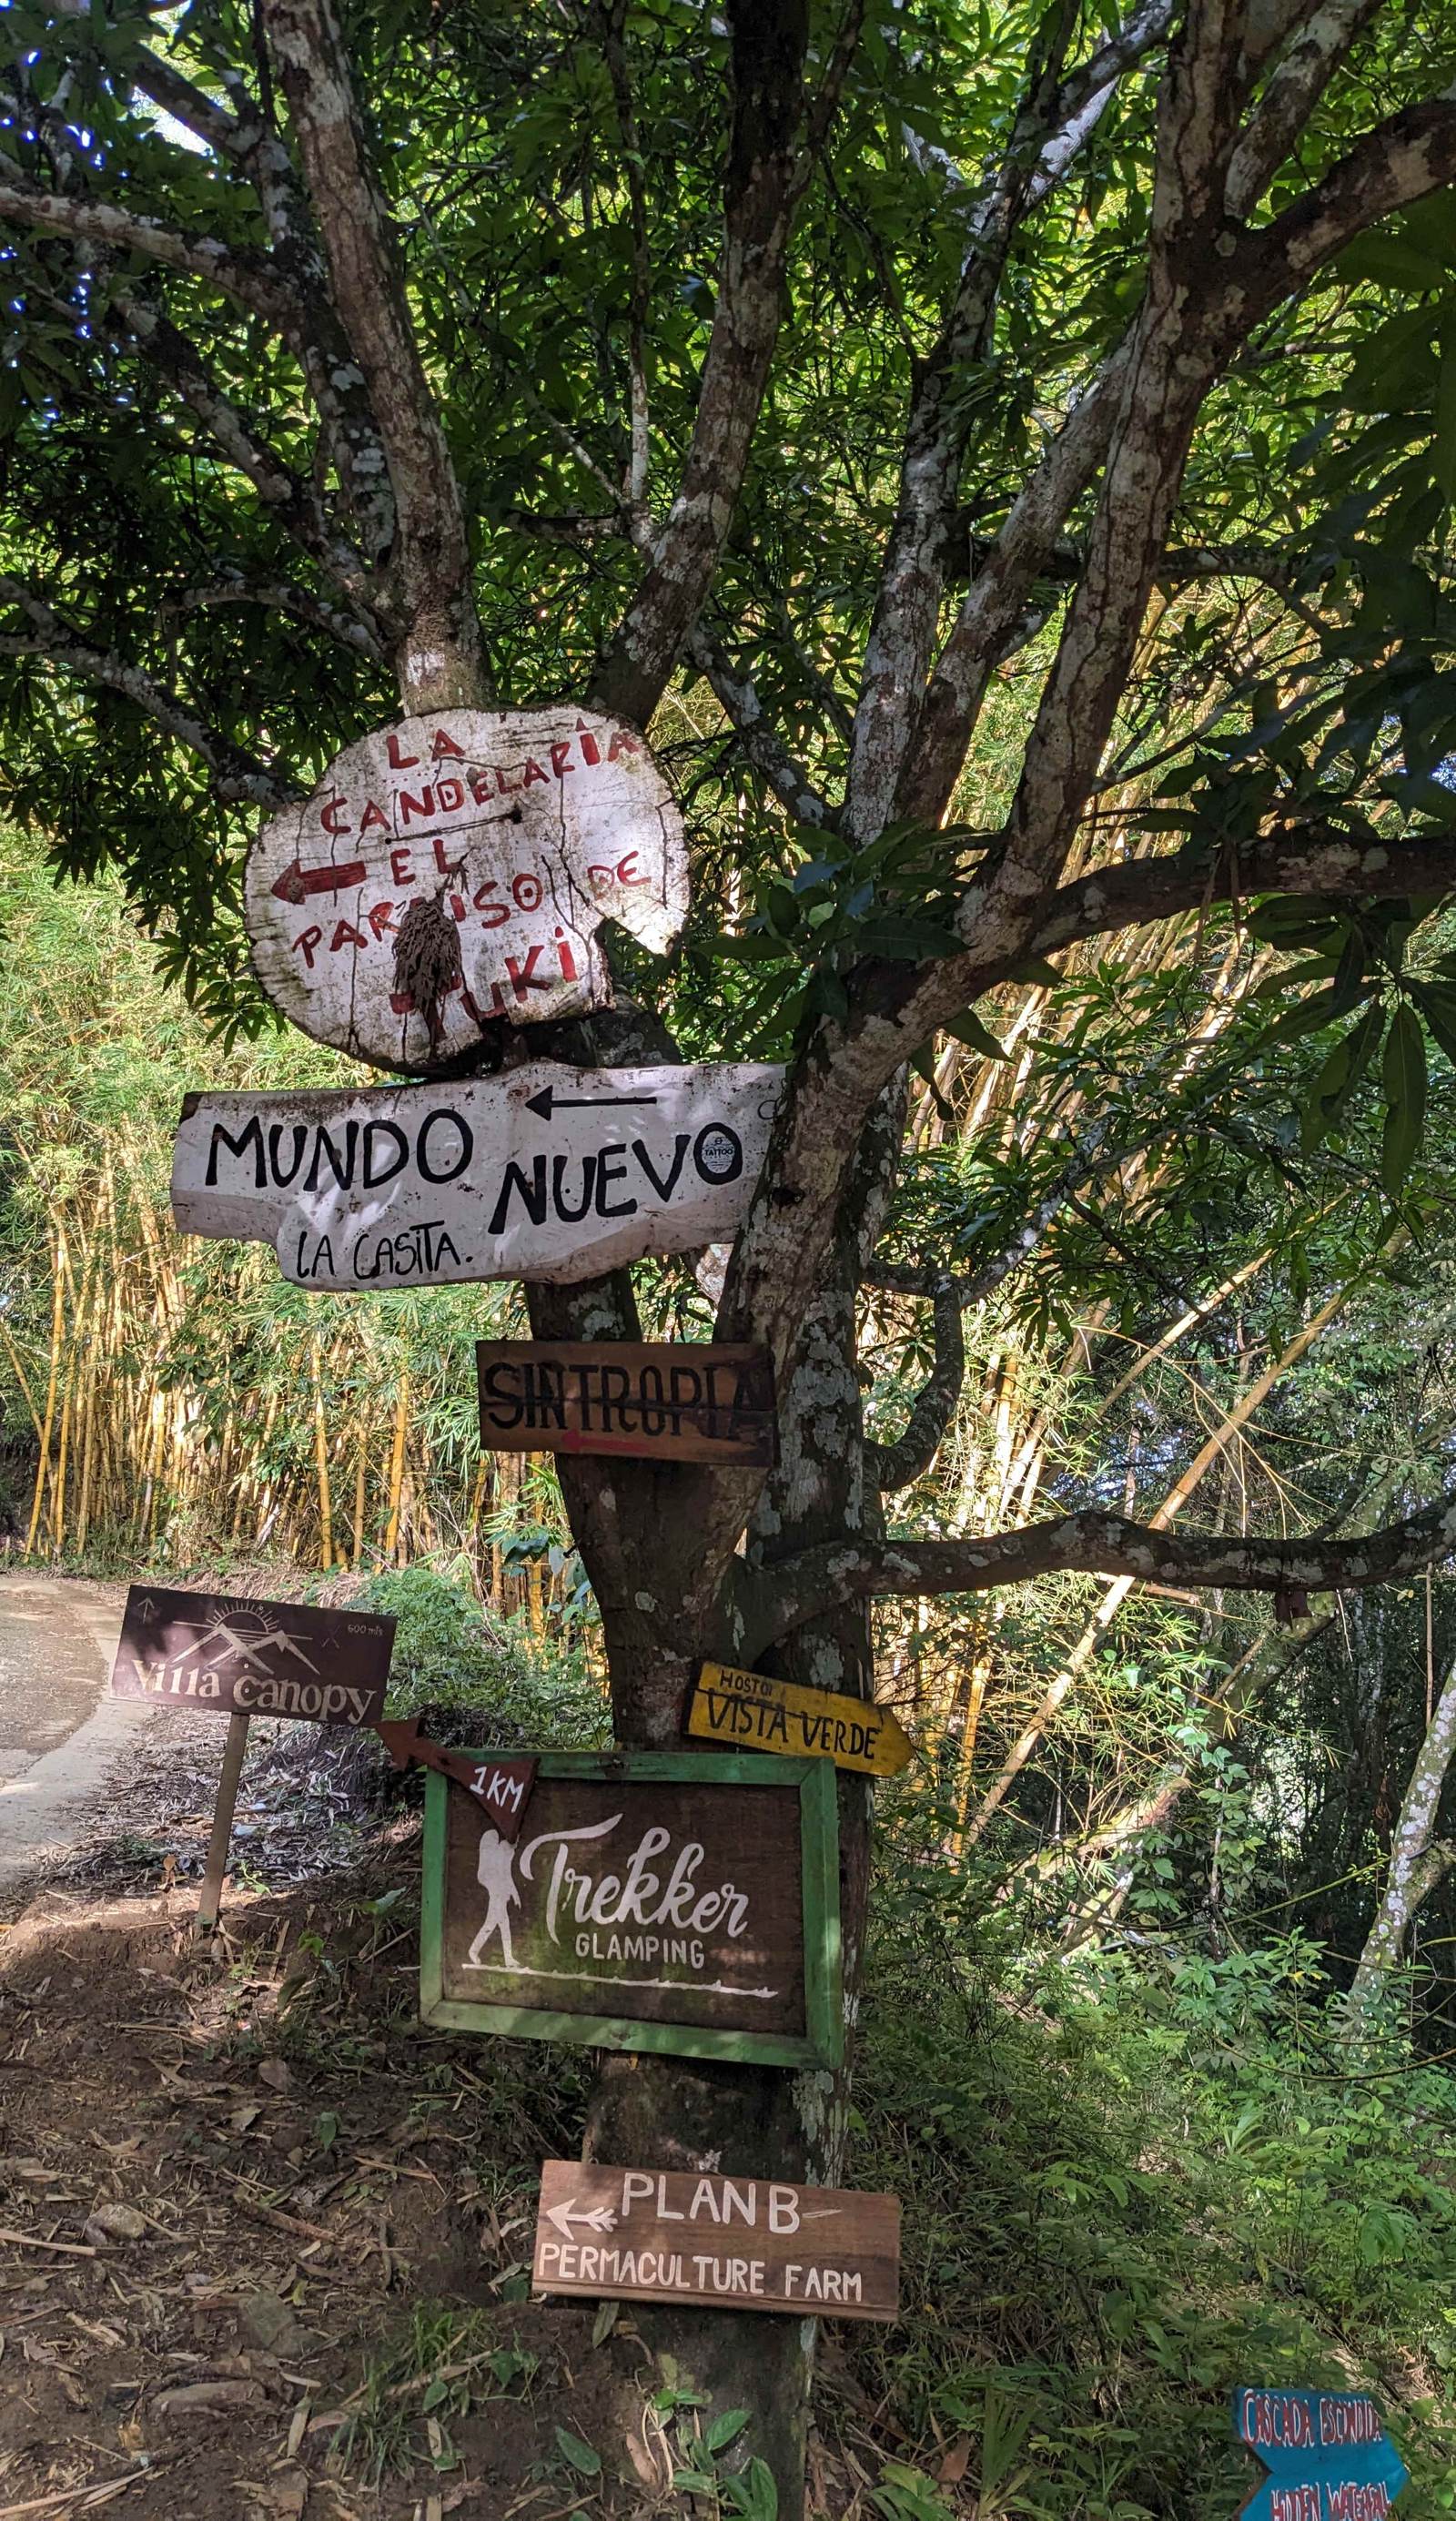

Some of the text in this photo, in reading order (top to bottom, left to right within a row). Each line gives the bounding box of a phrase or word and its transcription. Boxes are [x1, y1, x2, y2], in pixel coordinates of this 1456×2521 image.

[387, 729, 465, 770] LA
[390, 838, 463, 886] EL
[292, 850, 652, 968] PARISO DE
[205, 1109, 743, 1235] MUNDO NUEVO
[297, 1231, 335, 1279] LA
[483, 1362, 770, 1441] SINTROPIA
[132, 1659, 221, 1698] Villa
[708, 1687, 882, 1759] VISTA VERDE
[469, 1766, 525, 1813] 1KM
[520, 1813, 749, 1946] Trekker
[575, 1933, 705, 1969] GLAMPING
[622, 2172, 756, 2226] PLAN
[538, 2243, 863, 2303] PERMACULTURE FARM
[1243, 2389, 1382, 2447] CASCADA ESCONDIDA
